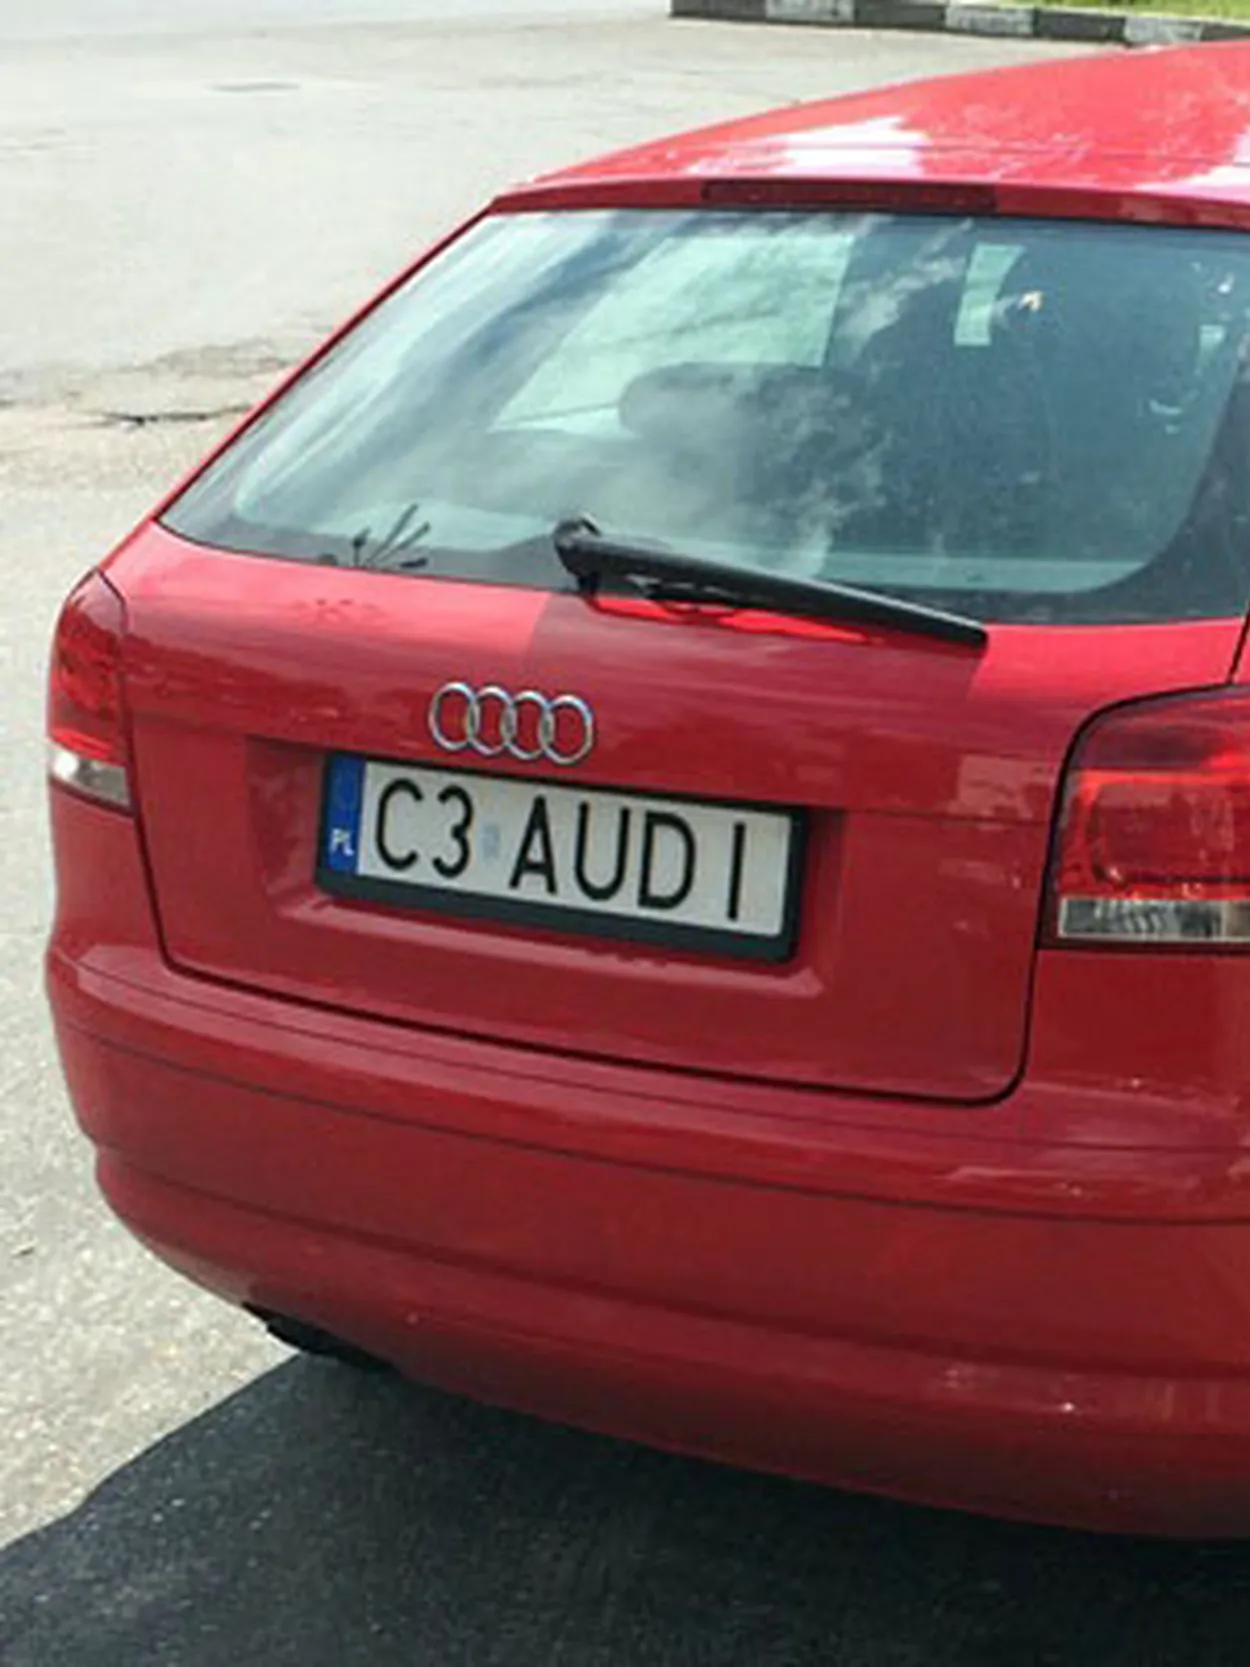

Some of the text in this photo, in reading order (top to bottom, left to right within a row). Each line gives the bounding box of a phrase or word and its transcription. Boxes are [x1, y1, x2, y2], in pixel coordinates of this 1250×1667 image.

[329, 828, 354, 856] PL
[376, 778, 746, 922] C3 AUDI
